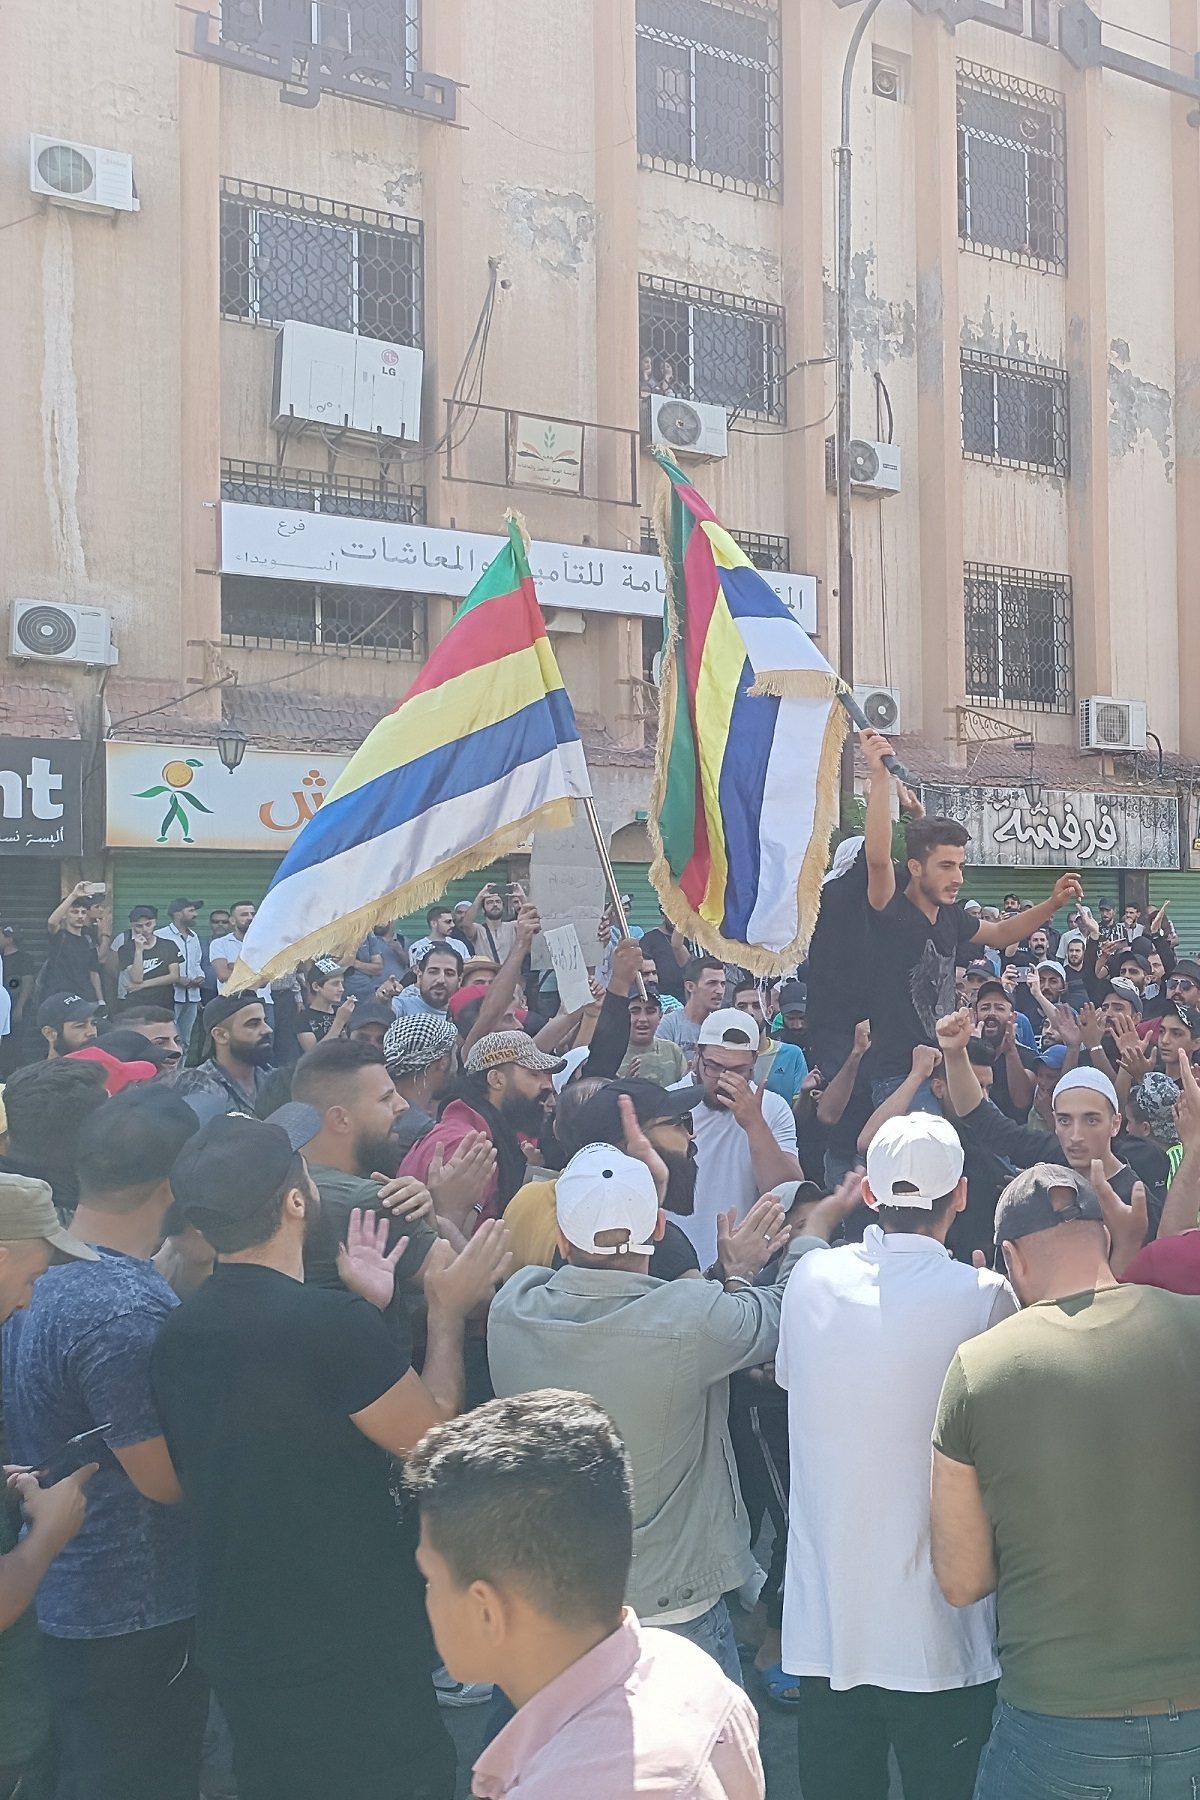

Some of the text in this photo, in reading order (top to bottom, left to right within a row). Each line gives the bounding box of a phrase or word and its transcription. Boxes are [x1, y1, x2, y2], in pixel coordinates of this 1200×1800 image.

[382, 366, 397, 377] LG
[276, 519, 306, 537] فرع
[235, 550, 339, 573] السويداء
[993, 799, 1118, 859] فرفشة
[63, 994, 82, 1006] FILA
